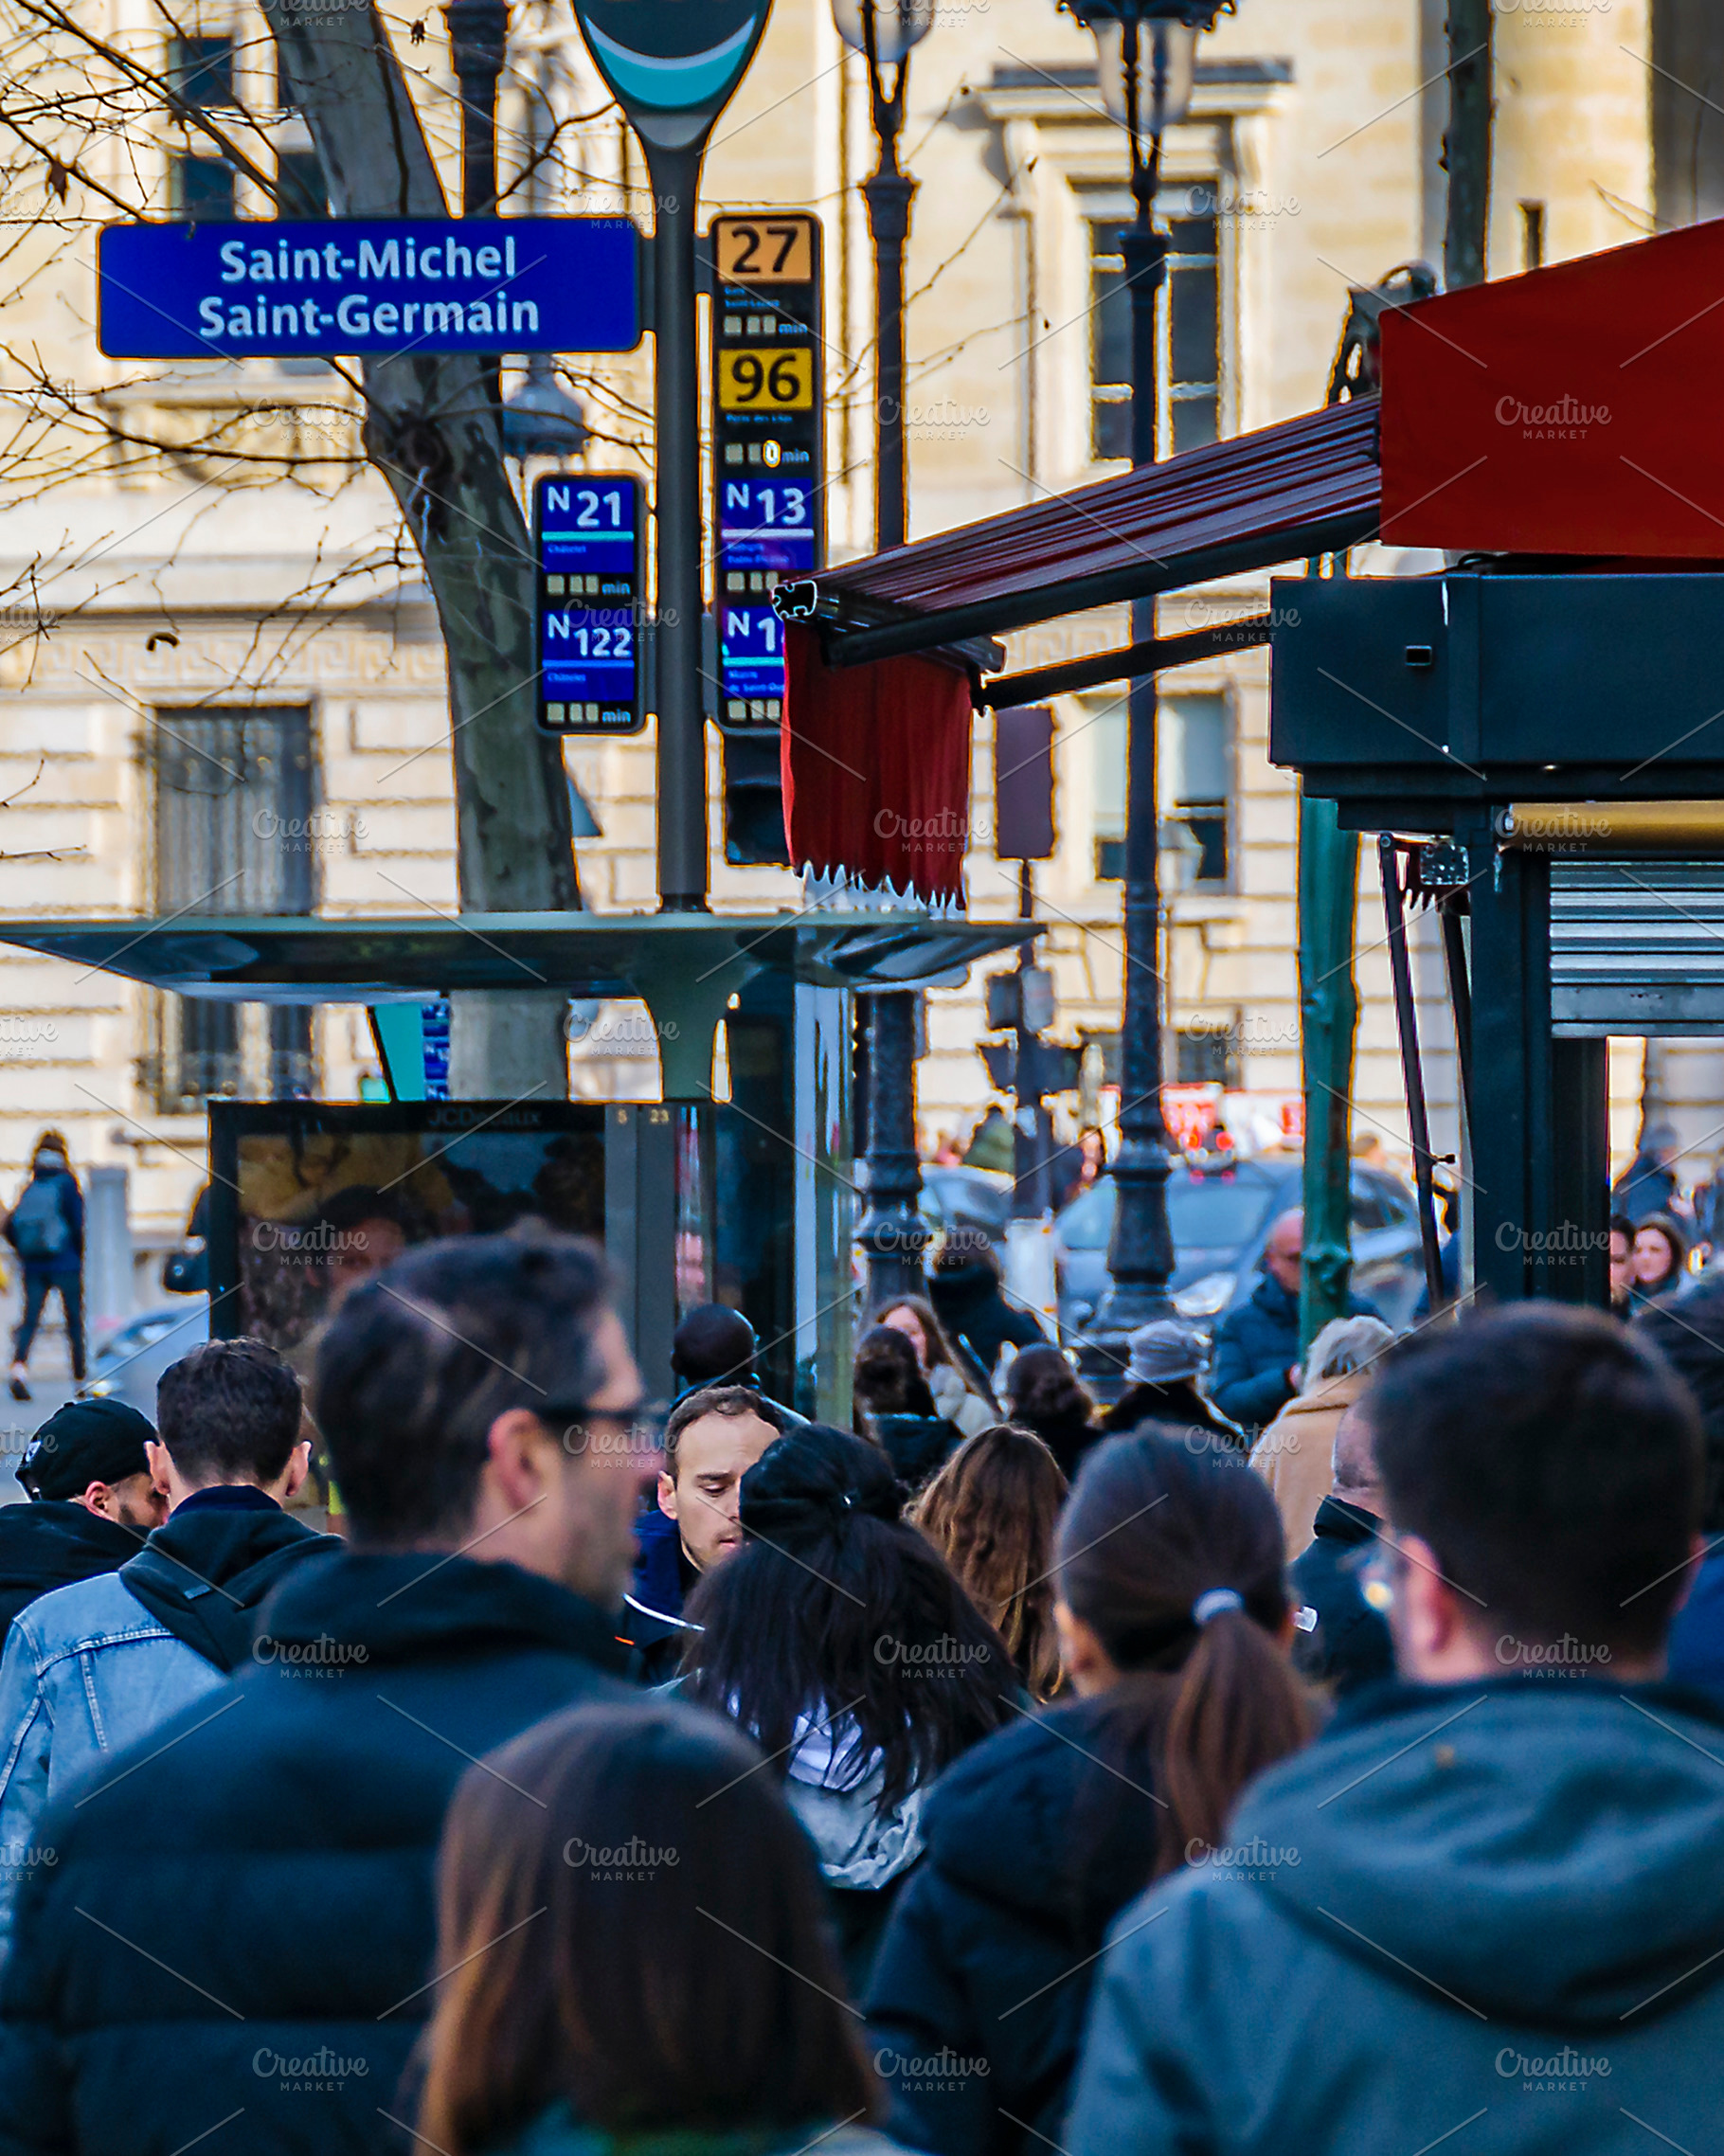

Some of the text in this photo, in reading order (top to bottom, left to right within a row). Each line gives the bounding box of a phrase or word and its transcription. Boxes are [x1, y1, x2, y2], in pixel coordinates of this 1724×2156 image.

[220, 236, 516, 281] Saint-Michel
[731, 223, 798, 273] 27
[198, 291, 539, 338] Saint-Germain
[732, 353, 799, 403] 96
[602, 581, 631, 595] min
[727, 610, 785, 652] N1
[602, 709, 632, 723] min
